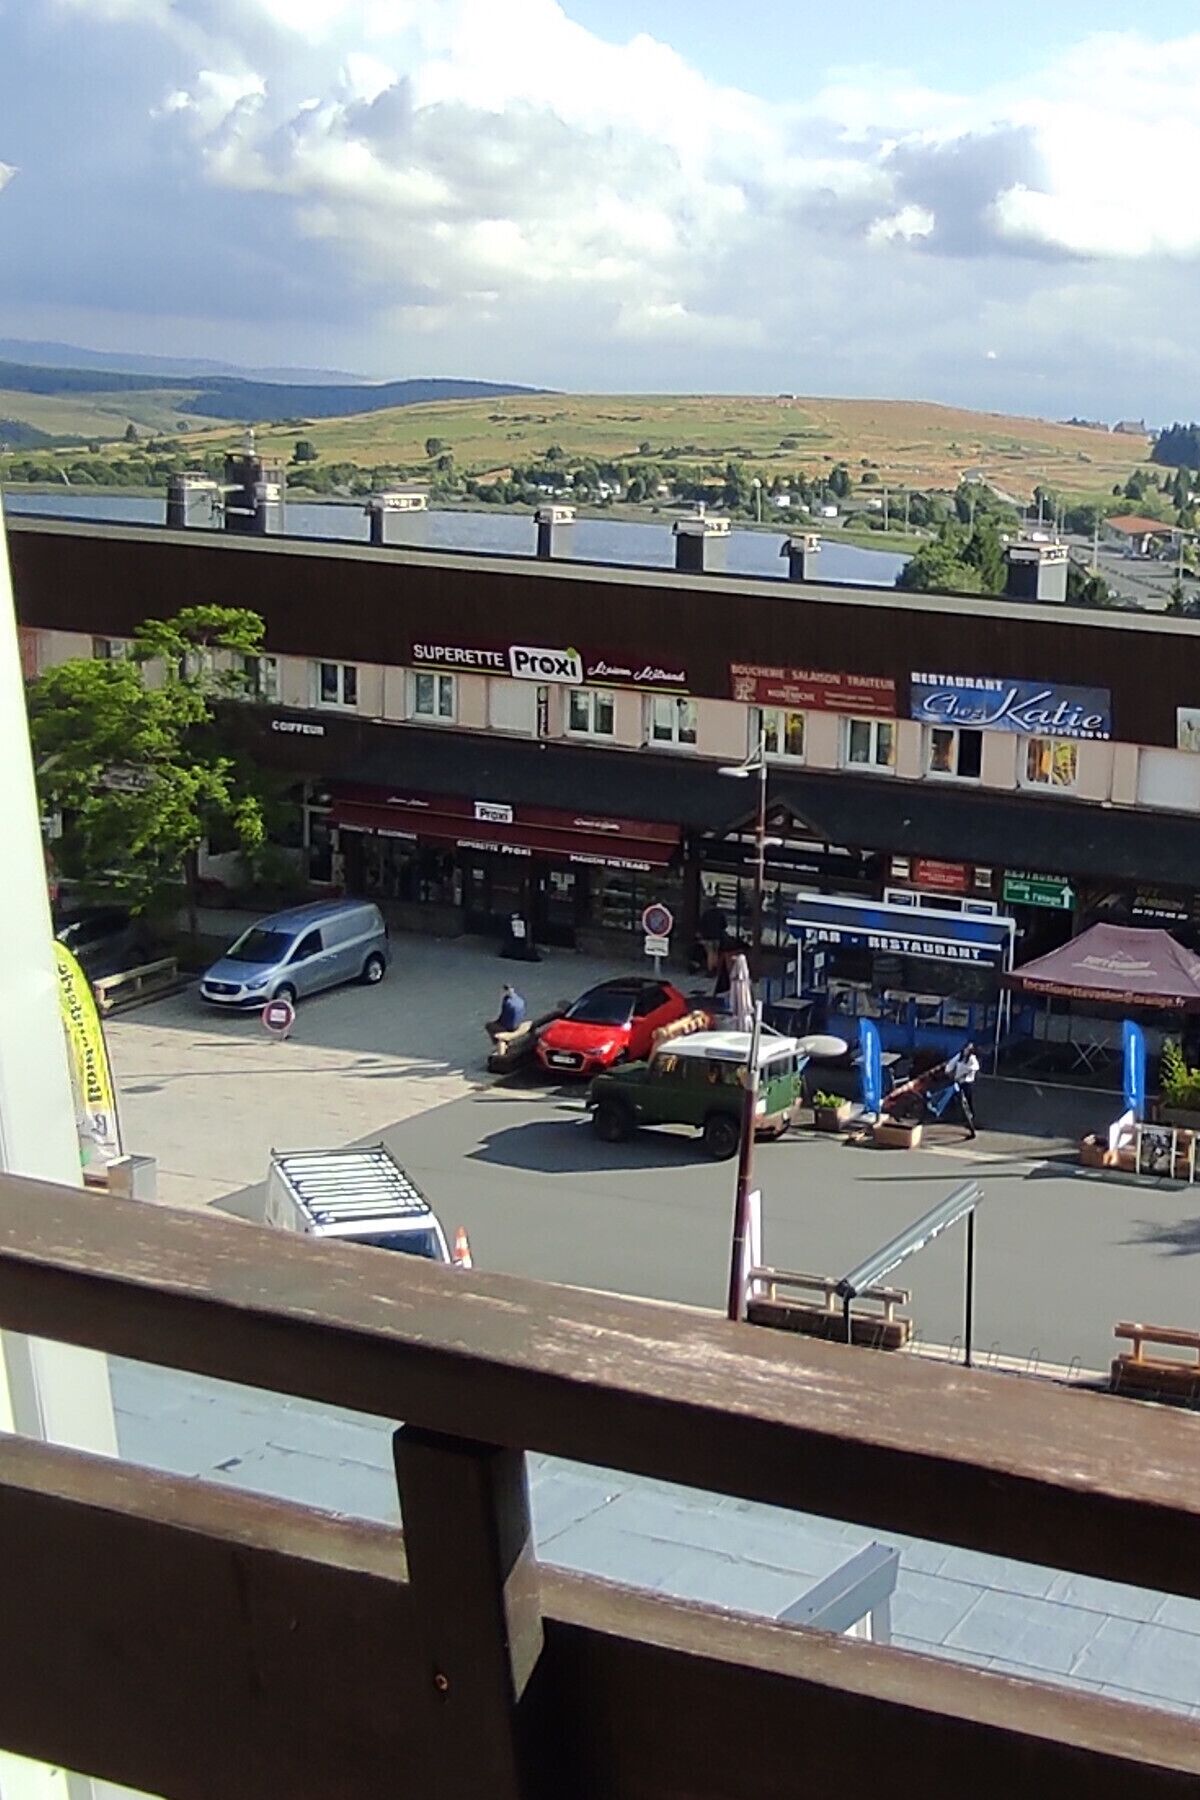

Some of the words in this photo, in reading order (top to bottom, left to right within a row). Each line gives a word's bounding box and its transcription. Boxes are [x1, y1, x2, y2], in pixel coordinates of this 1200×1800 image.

[413, 644, 505, 668] SUPERETTE
[731, 664, 785, 679] BOUCHERIE
[792, 671, 841, 685] SALAISON
[848, 676, 896, 691] TRAITEUR
[911, 671, 1003, 691] RESTAURANT
[923, 692, 987, 720] Chez
[950, 687, 1104, 731] Katie
[867, 936, 981, 960] RESTAURANT
